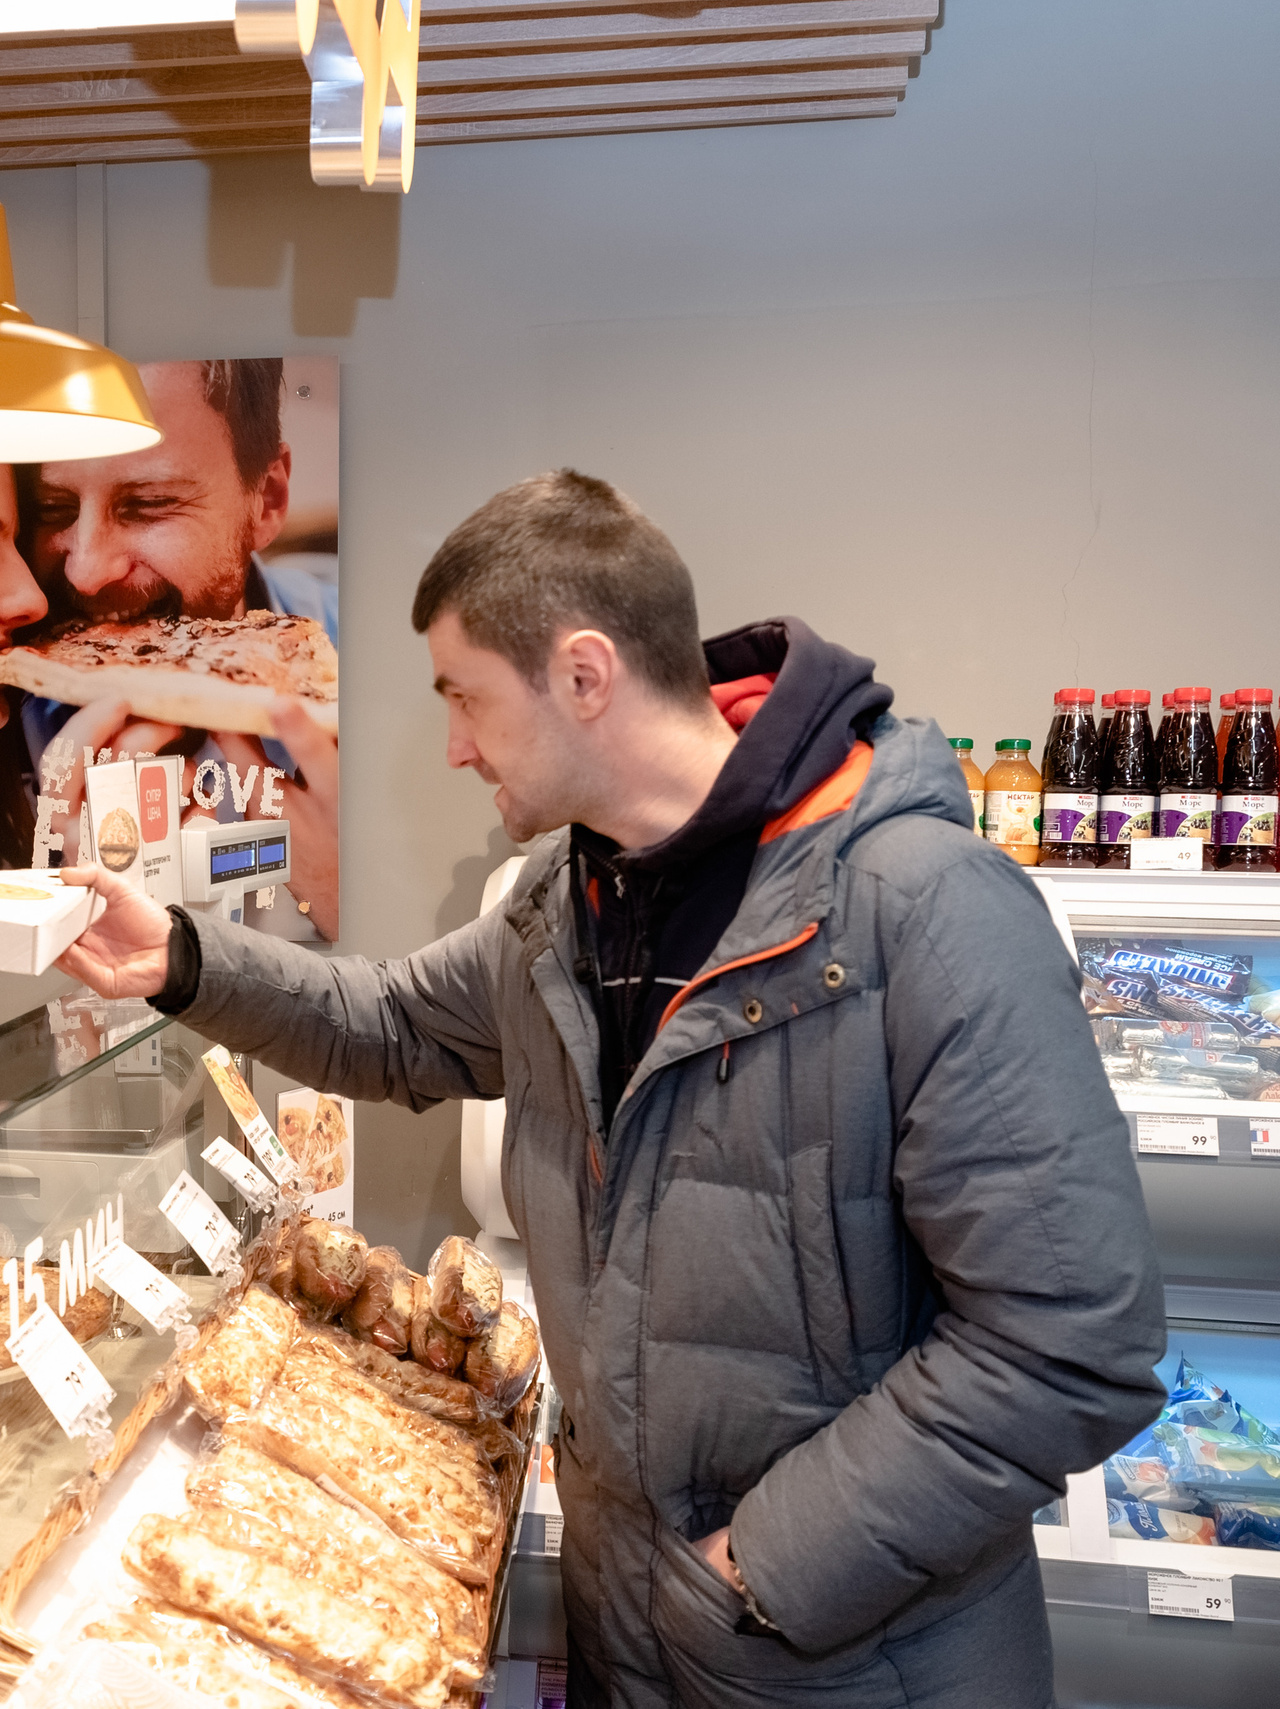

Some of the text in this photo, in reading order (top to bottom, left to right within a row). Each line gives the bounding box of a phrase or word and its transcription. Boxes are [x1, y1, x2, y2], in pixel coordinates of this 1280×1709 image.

[145, 788, 162, 803] СУПЕР
[1077, 799, 1095, 808] Морс
[1122, 800, 1143, 809] Морс
[1180, 799, 1202, 808] Морс
[1243, 800, 1265, 809] Морс
[147, 806, 162, 822] ЦЕНА
[1177, 852, 1191, 861] 49
[1192, 1136, 1207, 1145] 99
[328, 1212, 336, 1223] 45
[205, 1221, 219, 1240] 79
[1, 1235, 47, 1332] 15
[1206, 1598, 1221, 1609] 59
